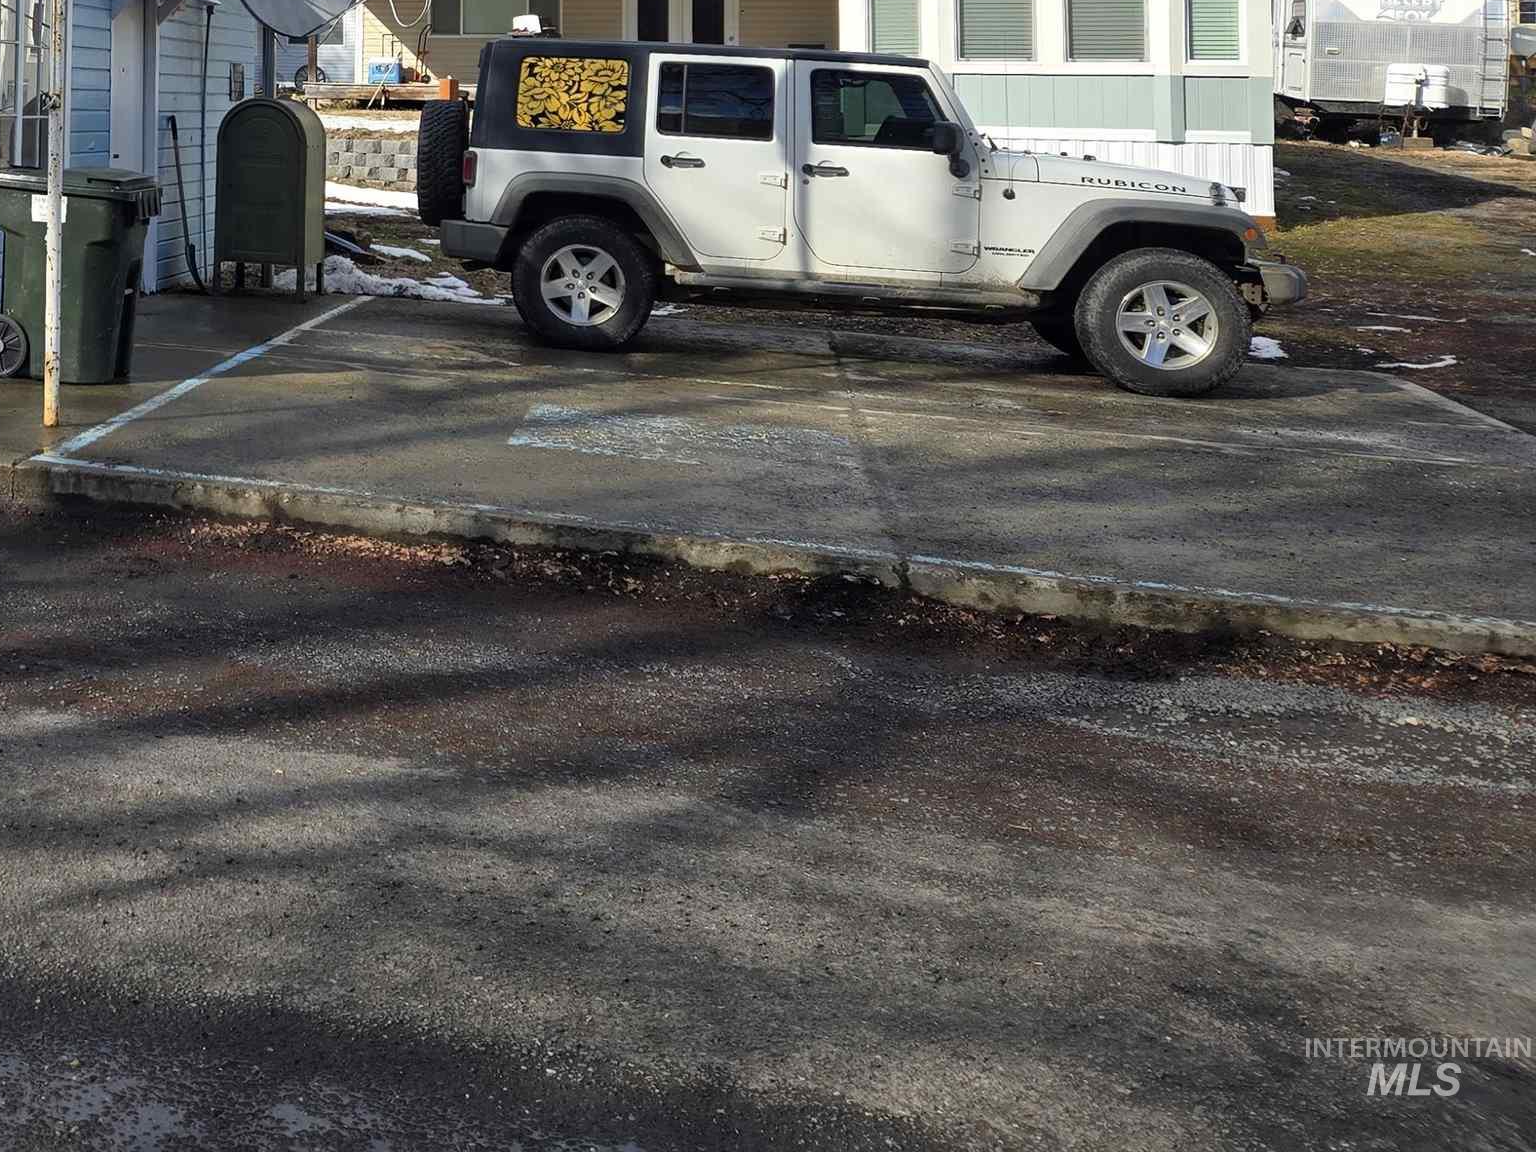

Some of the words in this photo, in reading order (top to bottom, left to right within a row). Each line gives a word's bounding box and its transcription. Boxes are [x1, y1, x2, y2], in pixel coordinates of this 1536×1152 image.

[1393, 9, 1431, 24] FOX
[1080, 176, 1187, 194] RUBICON
[983, 247, 1035, 255] WRANGLER
